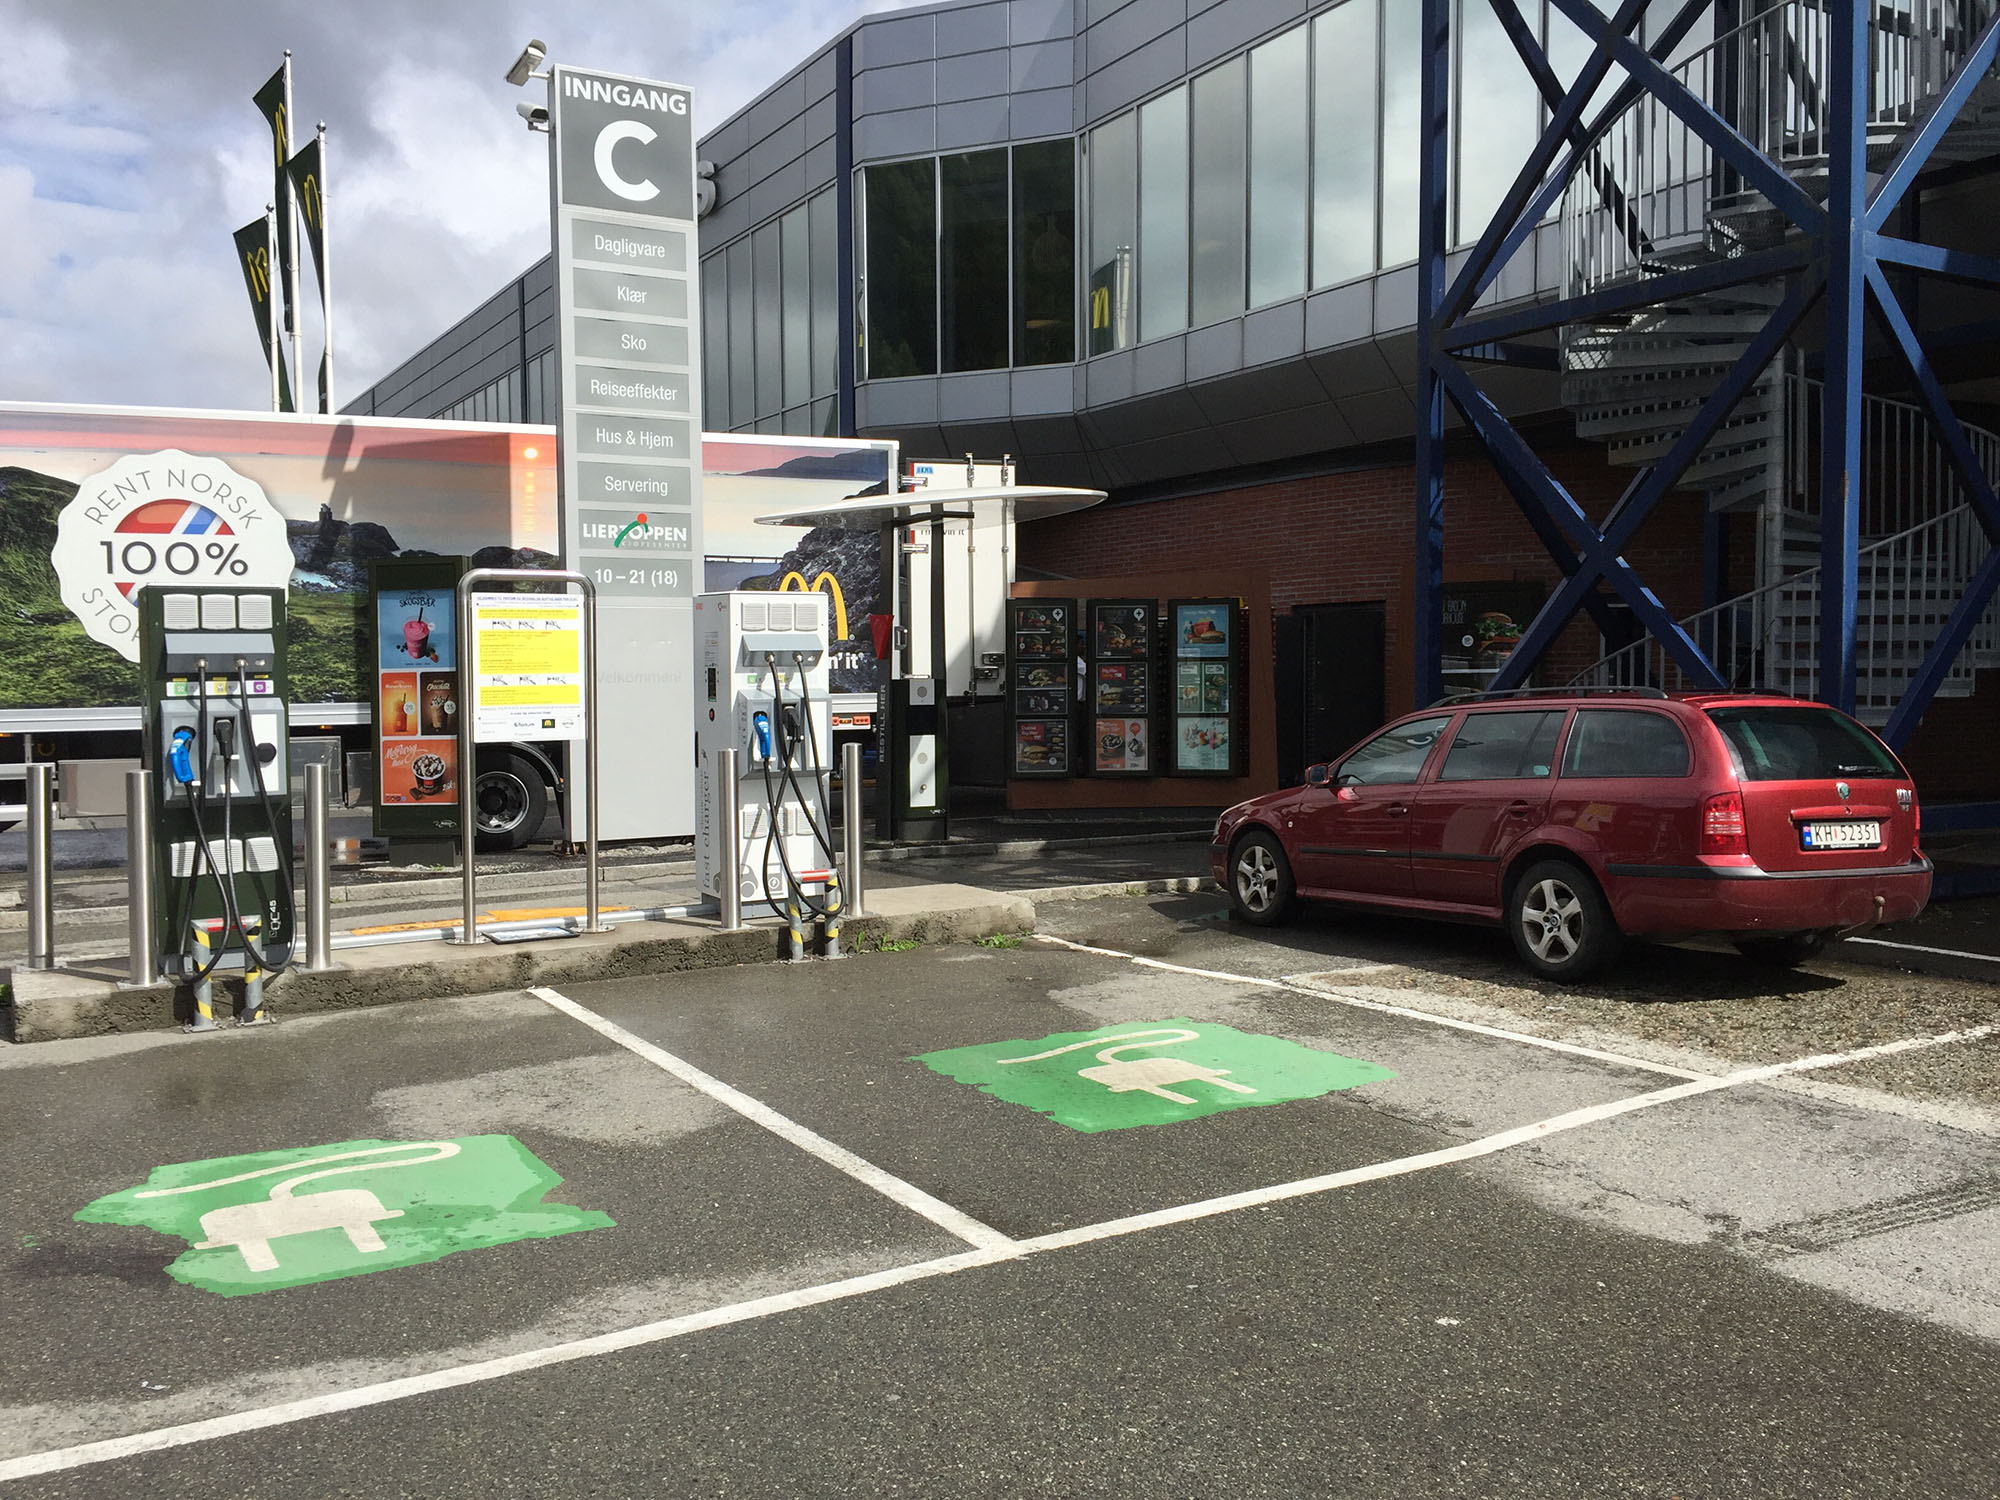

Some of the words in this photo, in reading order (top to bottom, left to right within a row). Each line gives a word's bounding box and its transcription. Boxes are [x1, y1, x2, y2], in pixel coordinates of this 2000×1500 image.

[564, 76, 687, 115] INNGANG
[594, 120, 661, 202] C
[594, 235, 666, 258] Dagligvare
[617, 285, 647, 304] Klær
[621, 334, 647, 351] Sko
[590, 379, 677, 401] Reiseeffekter
[596, 428, 622, 445] Hus
[626, 430, 636, 445] &
[640, 431, 674, 450] Hjem
[604, 476, 668, 497] Servering
[84, 470, 151, 525] RENT
[167, 469, 262, 529] NORSK
[100, 540, 248, 576] 100%
[595, 568, 612, 584] 10
[629, 569, 645, 584] 21
[651, 570, 678, 588] (18)
[879, 712, 887, 763] BESTILL
[701, 771, 712, 848] charger
[1814, 824, 1833, 843] KH
[1841, 823, 1878, 841] 52351
[702, 853, 711, 889] fast
